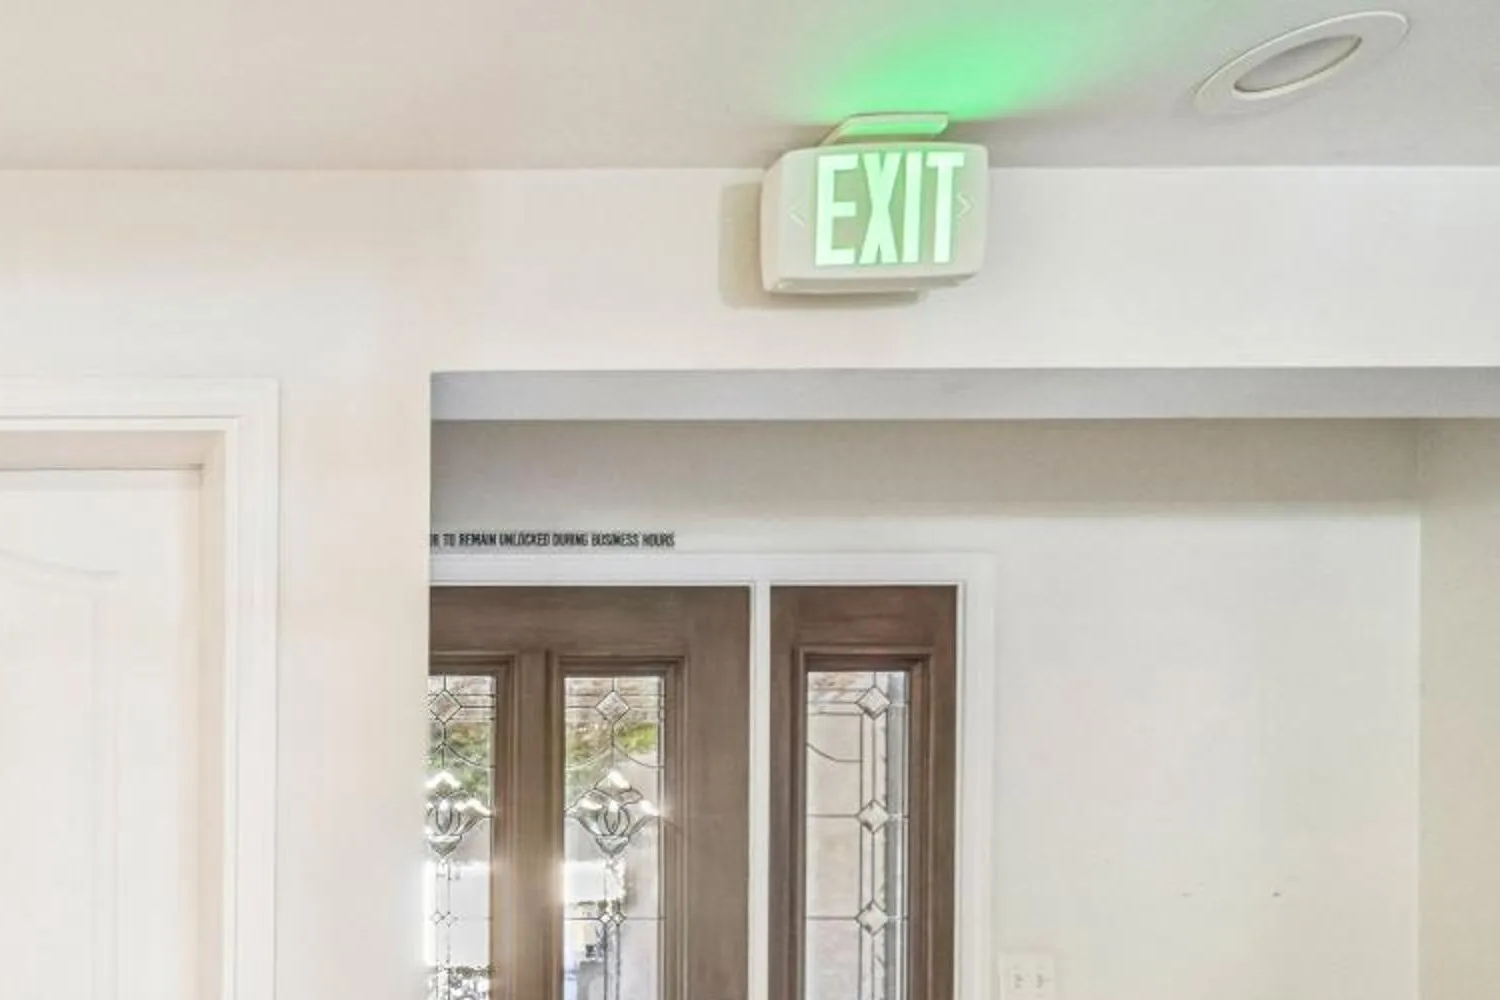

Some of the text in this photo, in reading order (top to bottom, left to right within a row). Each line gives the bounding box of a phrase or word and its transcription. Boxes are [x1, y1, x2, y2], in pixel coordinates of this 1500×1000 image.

[815, 151, 965, 266] EXIT
[443, 532, 457, 547] TO
[459, 532, 497, 547] REMAIN
[499, 532, 550, 547] UNLOCKED
[552, 532, 587, 547] DURING
[591, 532, 639, 547] BUSINESS
[642, 532, 675, 547] HOURS
